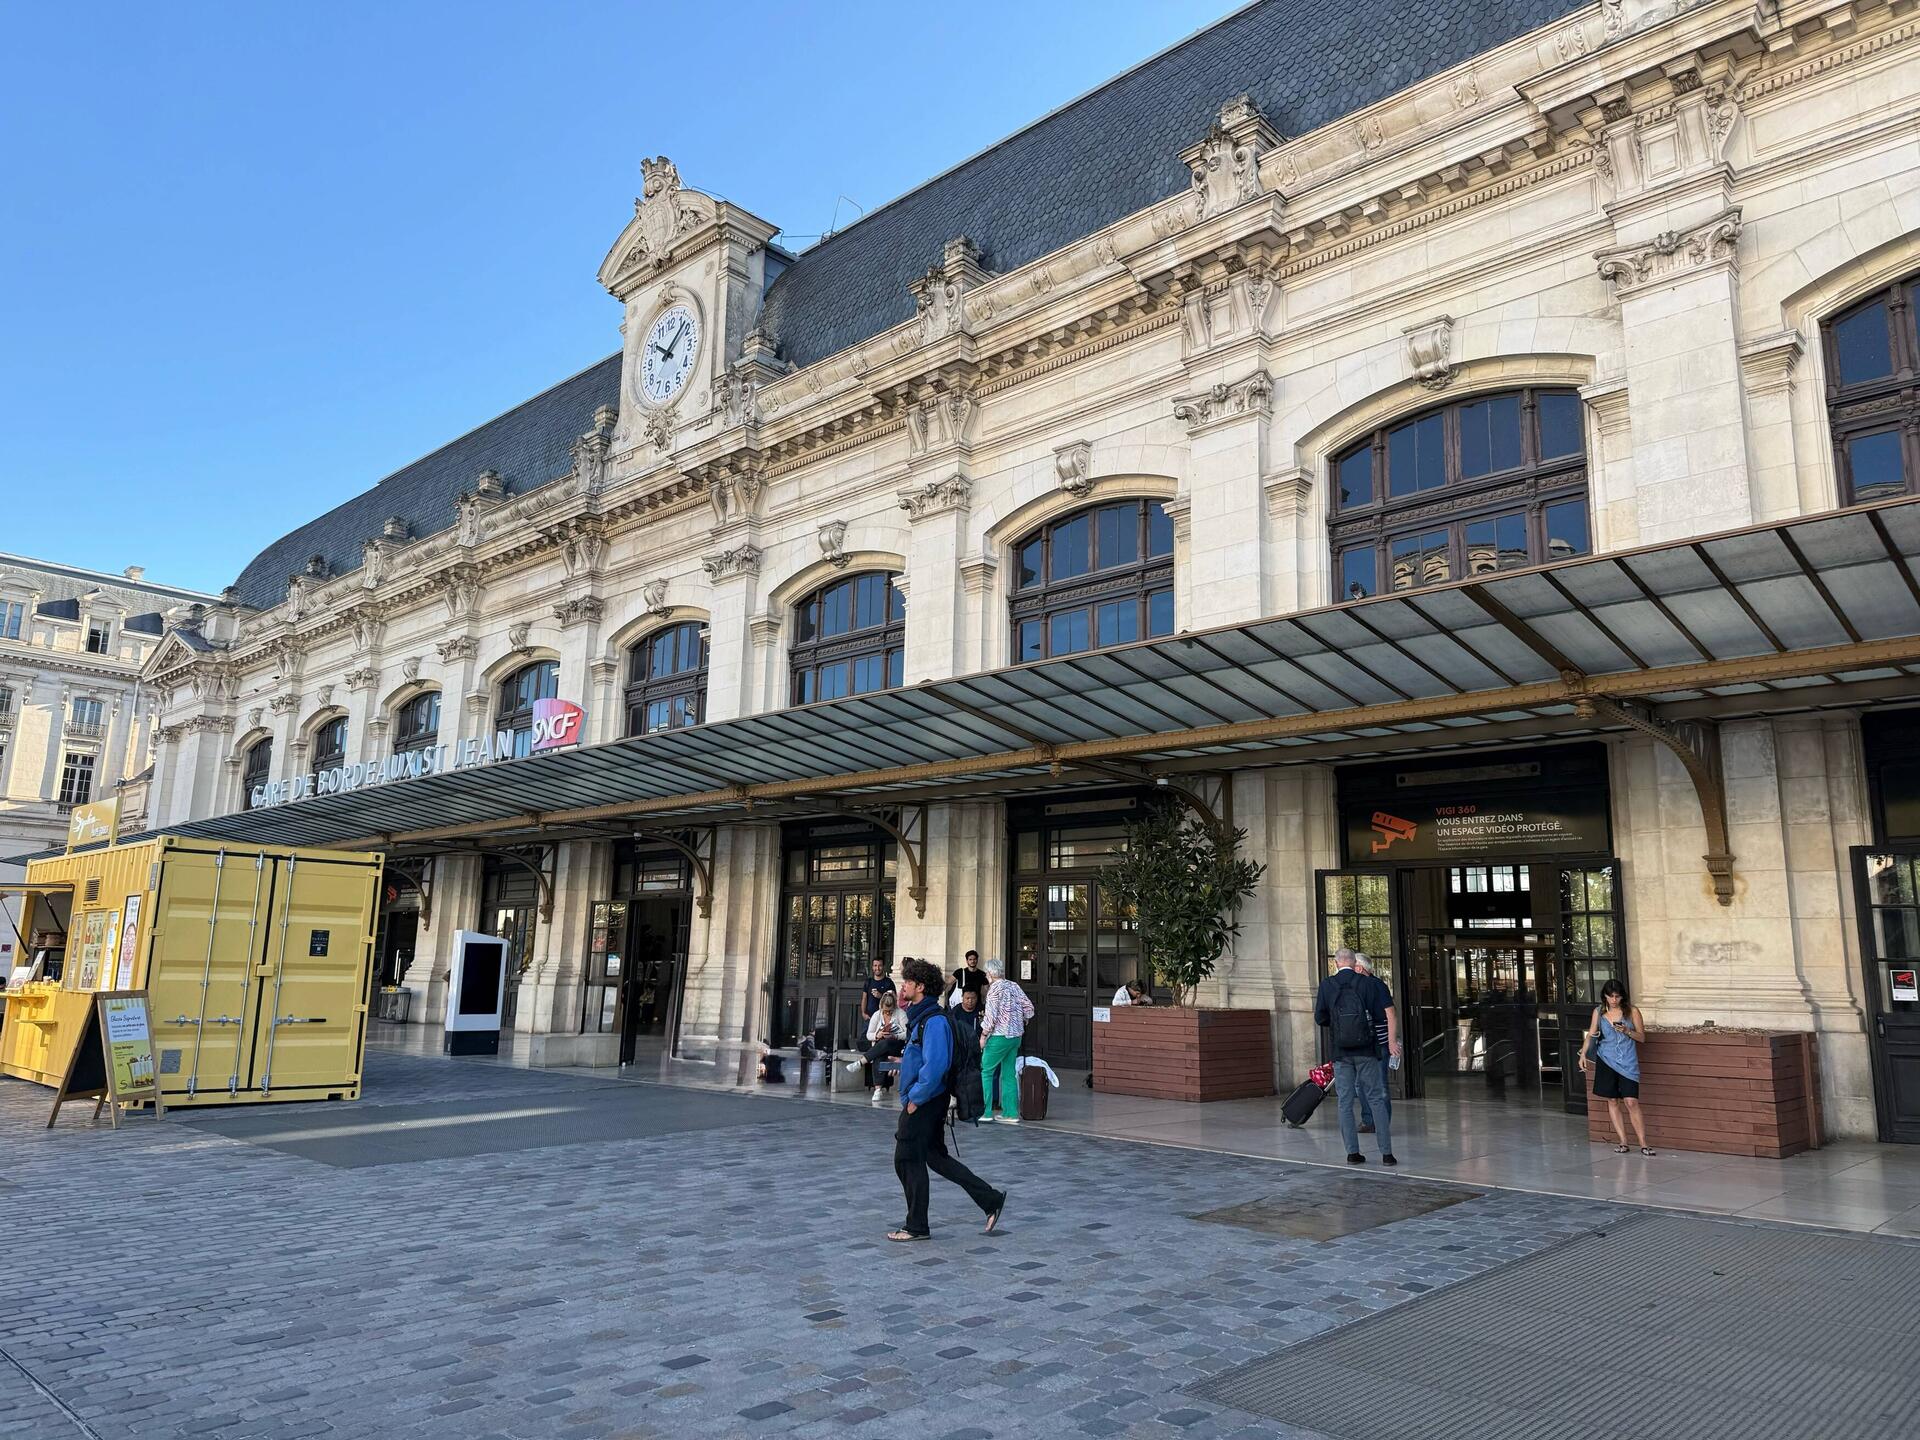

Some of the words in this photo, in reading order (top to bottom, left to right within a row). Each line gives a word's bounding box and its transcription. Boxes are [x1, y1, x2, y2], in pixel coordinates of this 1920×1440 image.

[667, 318, 675, 330] 12
[685, 323, 690, 336] 2
[658, 326, 664, 339] 11
[651, 342, 658, 355] 10
[687, 339, 692, 351] 3
[647, 359, 653, 371] 9
[683, 355, 688, 368] 4
[649, 374, 654, 385] 8
[676, 372, 681, 384] 5
[656, 381, 661, 394] 7
[665, 381, 670, 393] 6
[532, 711, 579, 744] SNCF
[251, 779, 290, 808] GARE
[292, 773, 316, 799] DE
[317, 750, 422, 795] BORDEAUX
[422, 744, 448, 774] ST
[454, 729, 515, 770] JEAN
[1436, 806, 1455, 816] VIGI
[1458, 805, 1476, 814] 360
[1436, 818, 1460, 826] VOUS
[1462, 815, 1496, 825] ENTREZ
[1498, 813, 1524, 822] DANS
[1437, 828, 1450, 837] UN
[1452, 825, 1484, 836] ESPACE
[1486, 823, 1515, 834] VIDÉO
[1517, 820, 1563, 832] PROTÉGÉ.
